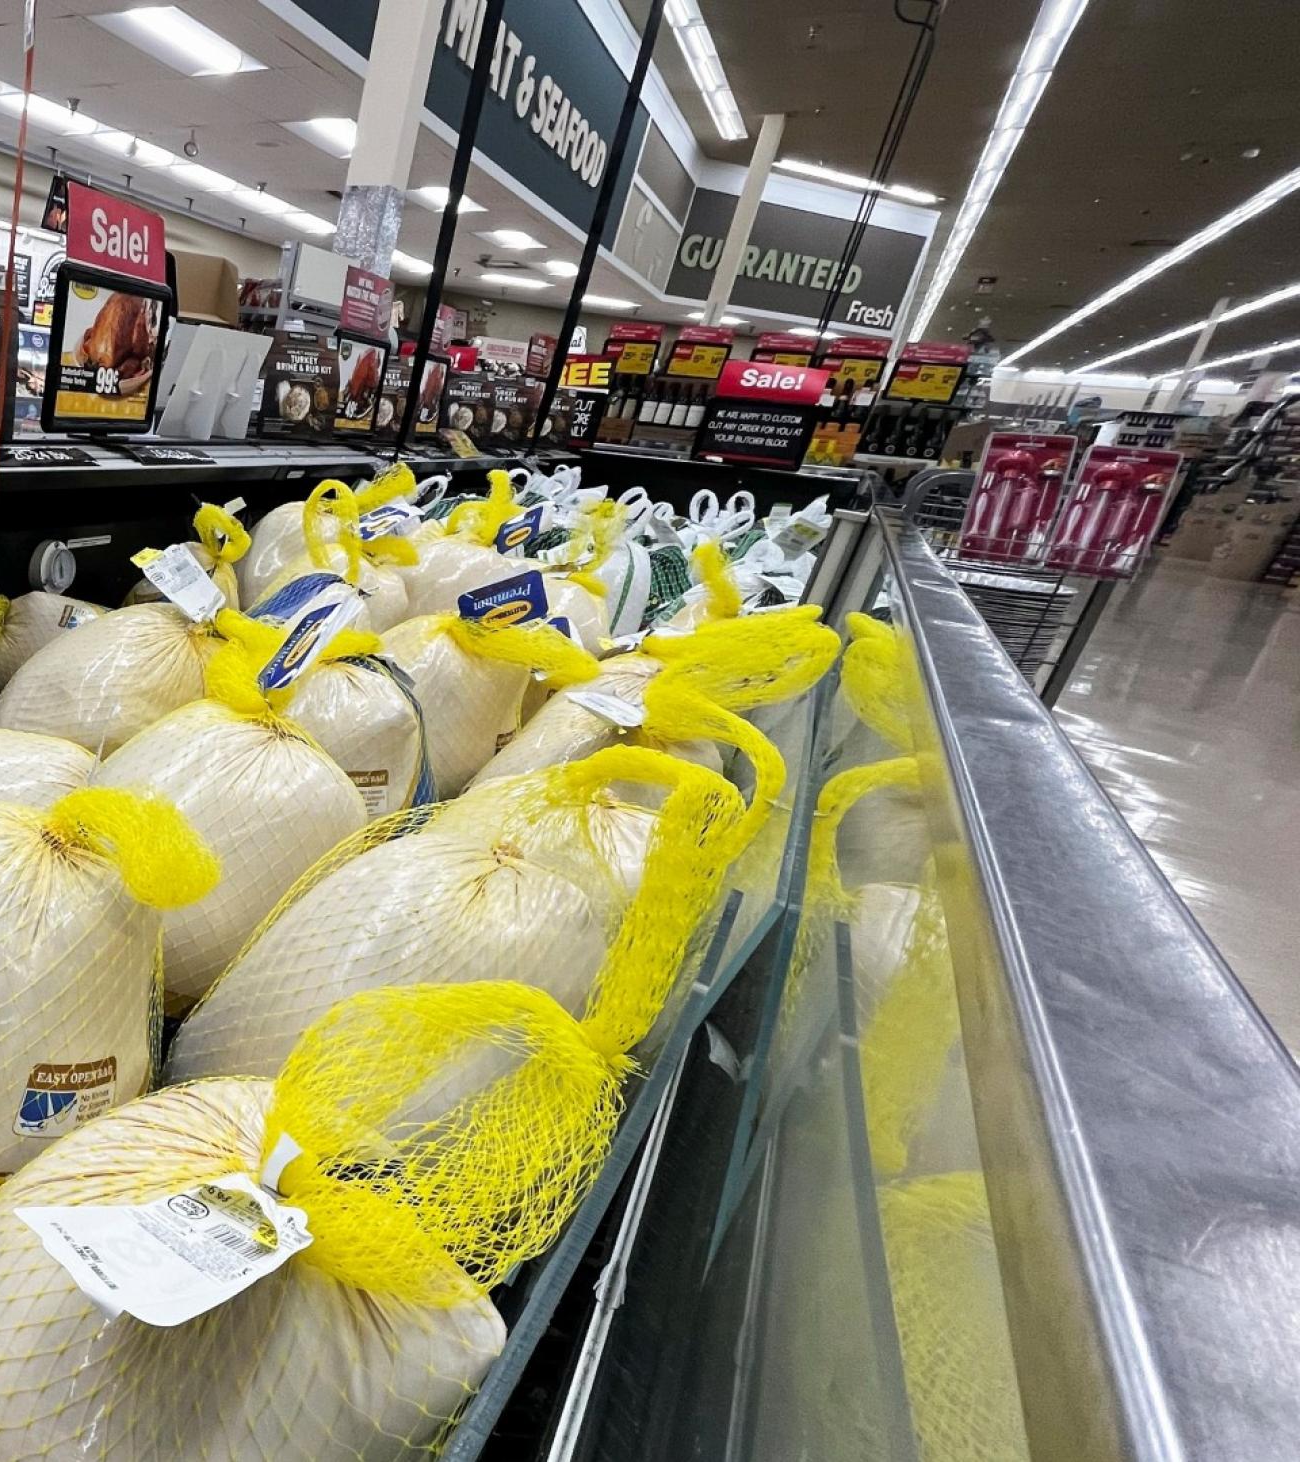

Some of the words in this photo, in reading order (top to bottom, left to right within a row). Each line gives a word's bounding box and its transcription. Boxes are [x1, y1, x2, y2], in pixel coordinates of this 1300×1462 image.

[444, 0, 522, 100] MT
[516, 55, 536, 118] &
[531, 75, 607, 188] SEAFOOD
[91, 208, 149, 265] Sale!
[681, 234, 862, 294] GURANTED
[847, 300, 893, 327] Fresh
[276, 362, 298, 372] BRINE
[305, 364, 320, 373] RUB
[321, 366, 332, 375] KIT
[291, 355, 318, 364] TURKEY
[559, 362, 611, 385] EE
[740, 368, 806, 390] Sale!
[741, 412, 760, 420] HAPPY
[762, 413, 771, 421] TO
[772, 413, 802, 423] CUSTOM
[708, 421, 723, 429] CUT
[723, 422, 737, 430] ANY
[738, 424, 759, 433] ORDER
[761, 426, 774, 434] FOR
[792, 428, 803, 437] AT
[715, 433, 734, 441] YOUR
[735, 435, 765, 445] BUTCHER
[765, 438, 788, 448] BLOCK
[36, 1071, 68, 1084] EASY
[69, 1069, 97, 1084] OPEN
